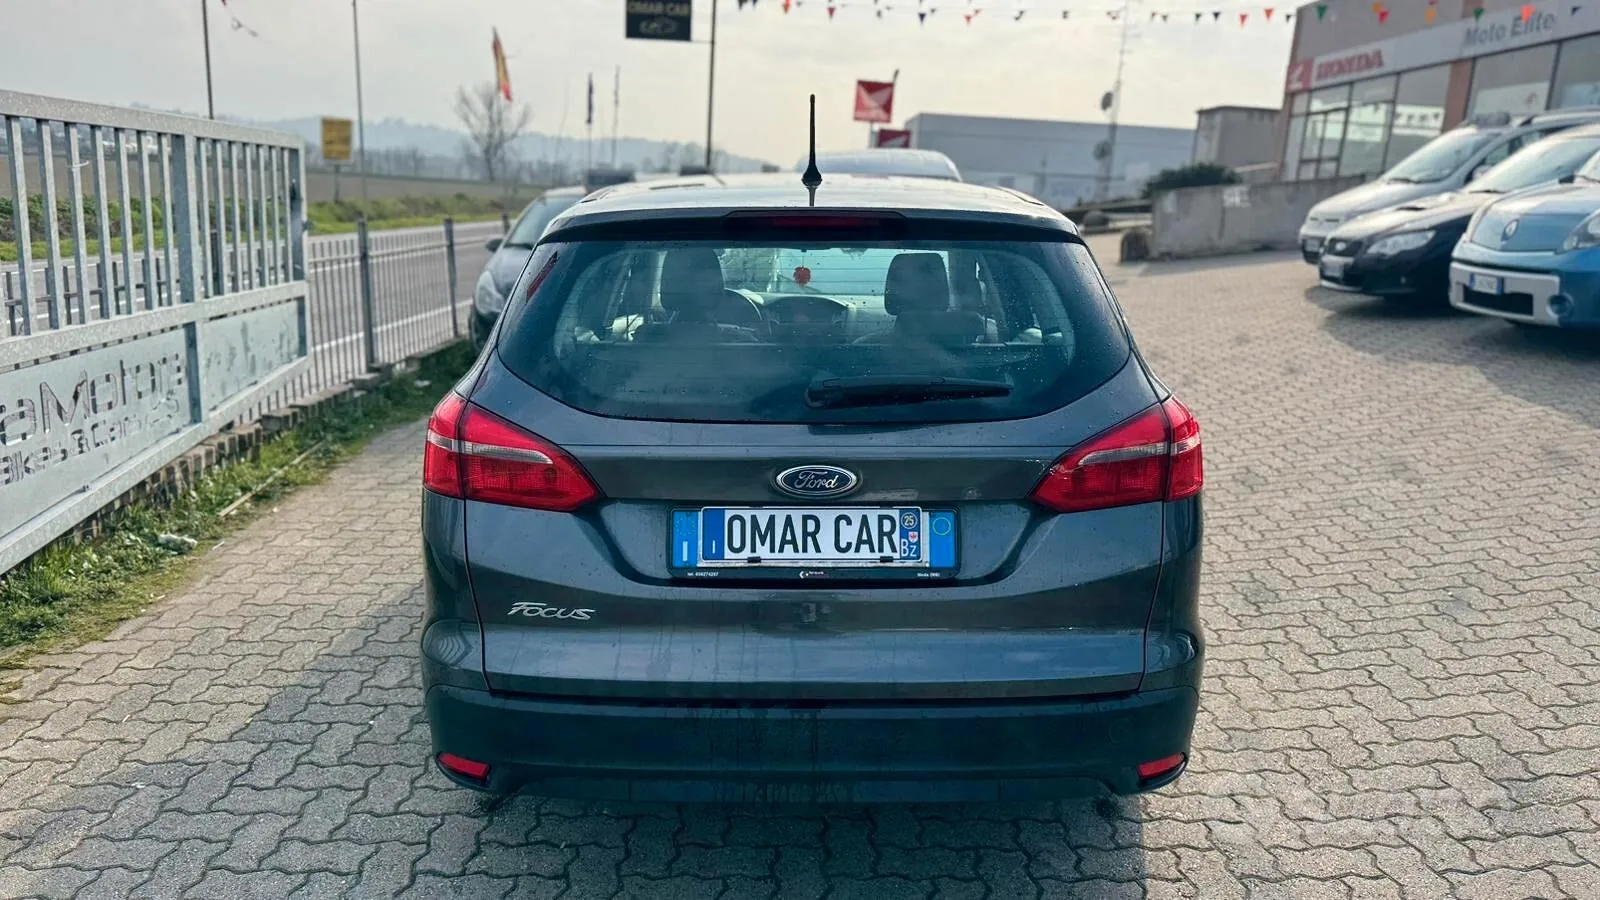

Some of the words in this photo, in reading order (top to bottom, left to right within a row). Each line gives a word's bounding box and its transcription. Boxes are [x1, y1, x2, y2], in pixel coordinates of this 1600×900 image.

[627, 1, 662, 13] OMAR
[667, 3, 689, 15] CAR
[1463, 22, 1507, 46] Moto
[1314, 48, 1384, 80] HONDA
[794, 470, 839, 488] Ford
[903, 515, 915, 526] 25
[727, 514, 821, 554] OMAR
[834, 514, 898, 554] CAR
